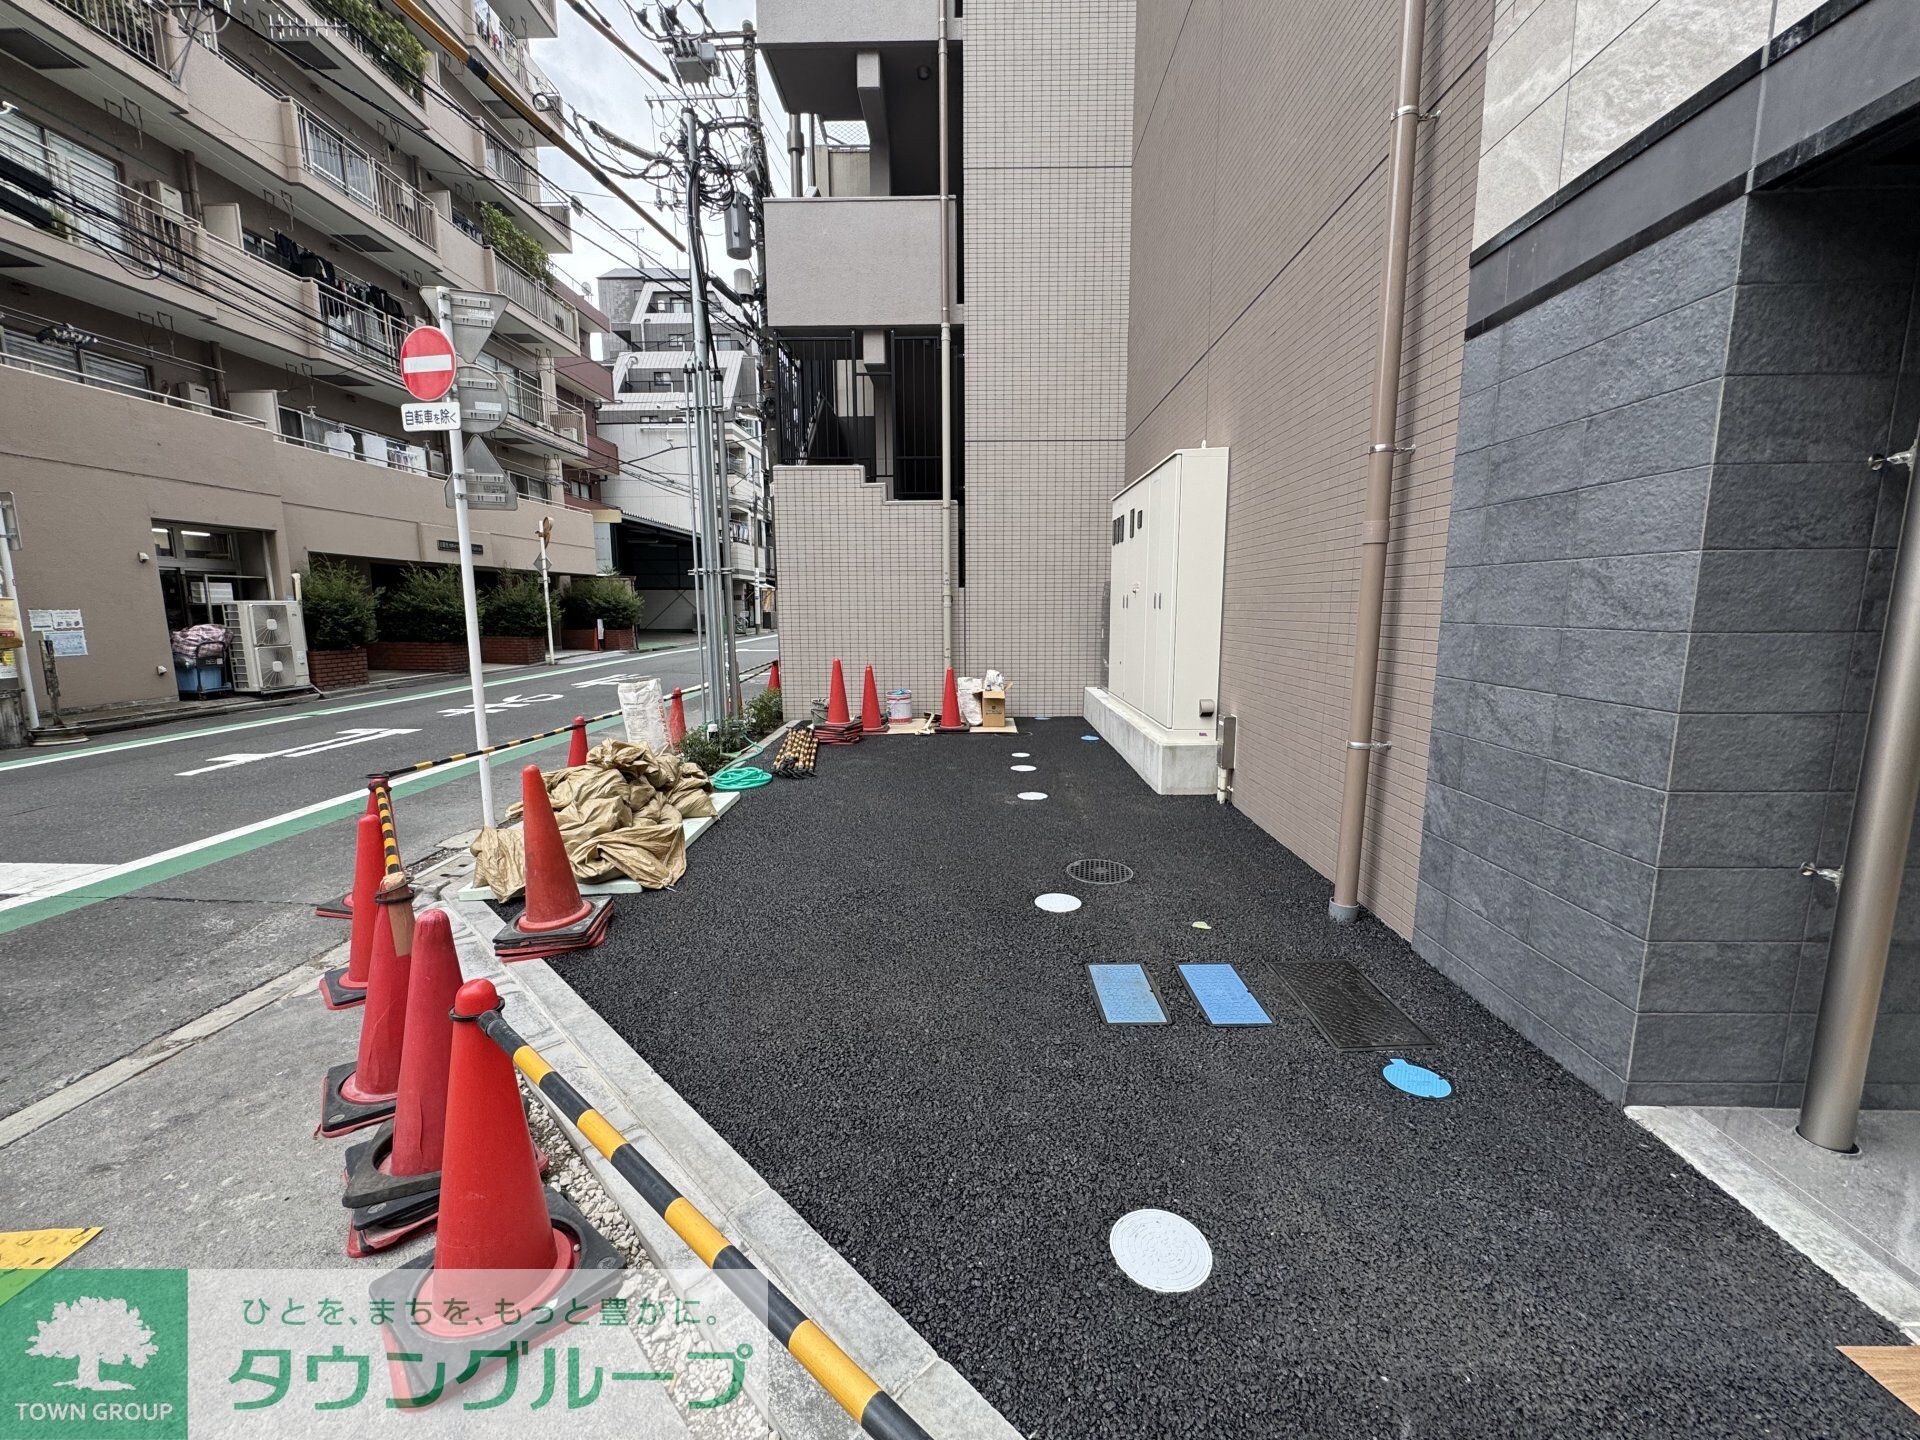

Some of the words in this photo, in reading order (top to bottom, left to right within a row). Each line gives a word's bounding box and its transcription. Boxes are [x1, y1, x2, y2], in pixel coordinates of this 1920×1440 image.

[405, 409, 457, 426] 自転車を除く
